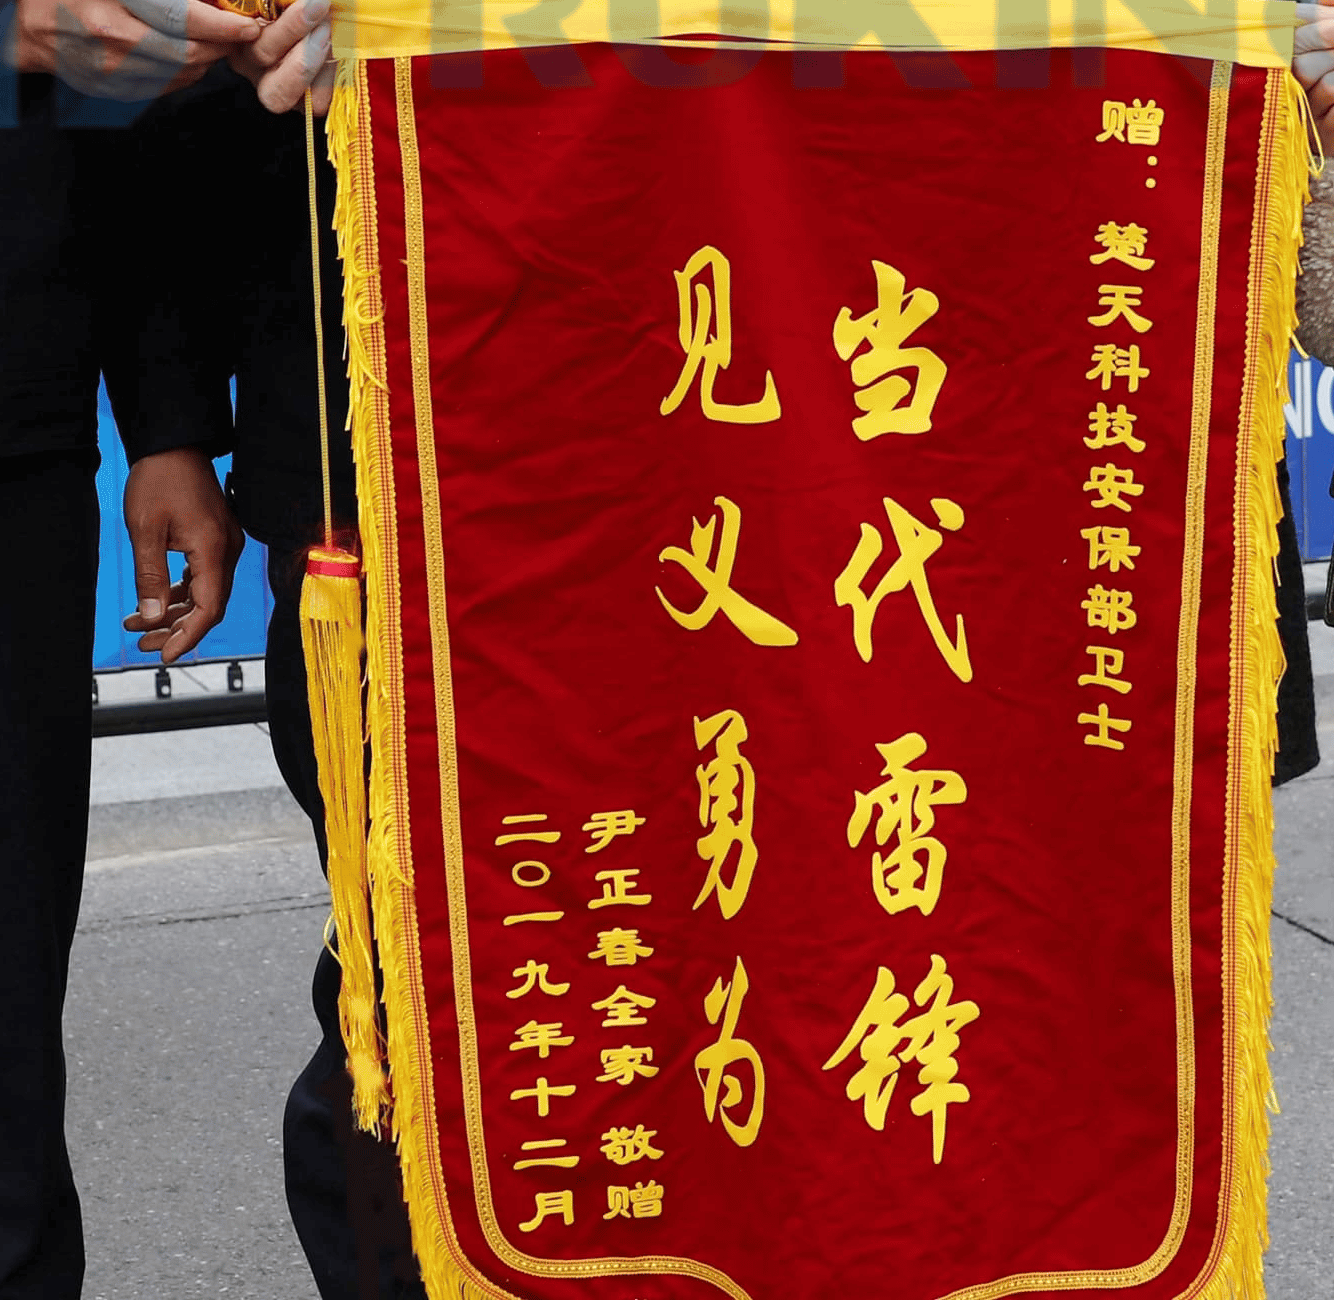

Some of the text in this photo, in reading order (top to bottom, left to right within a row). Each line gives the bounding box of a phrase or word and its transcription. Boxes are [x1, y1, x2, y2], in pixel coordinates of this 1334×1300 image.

[655, 244, 799, 1147] 见义勇为
[822, 259, 981, 1165] 当代雷锋
[1077, 220, 1156, 751] 楚天科技安保部卫士
[581, 809, 665, 1220] 尹正春全家 敬赠
